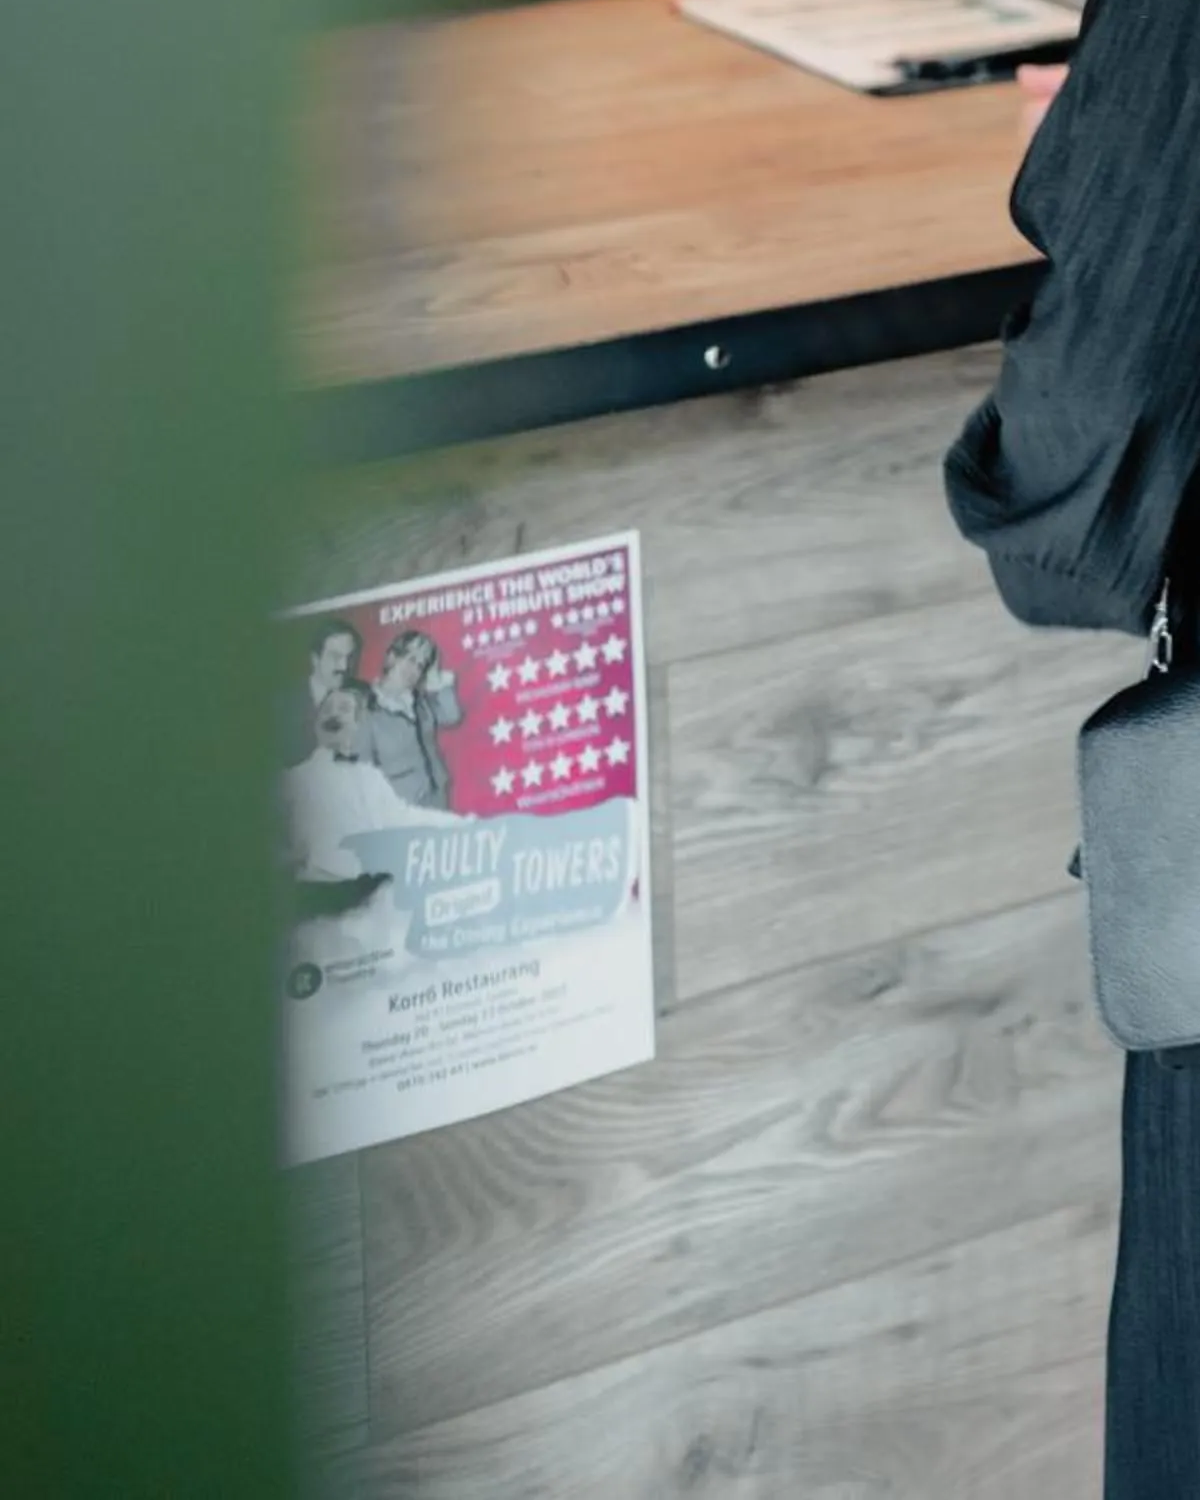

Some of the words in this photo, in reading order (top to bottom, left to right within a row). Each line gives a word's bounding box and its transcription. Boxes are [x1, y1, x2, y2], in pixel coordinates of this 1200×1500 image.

[379, 581, 494, 625] EXPERIENCE
[500, 573, 535, 598] THE
[488, 590, 563, 621] TRIBUTE
[567, 573, 626, 601] SHOW
[404, 823, 507, 888] FAULTY
[512, 833, 622, 897] TOWERS
[441, 959, 541, 998] Restaurang
